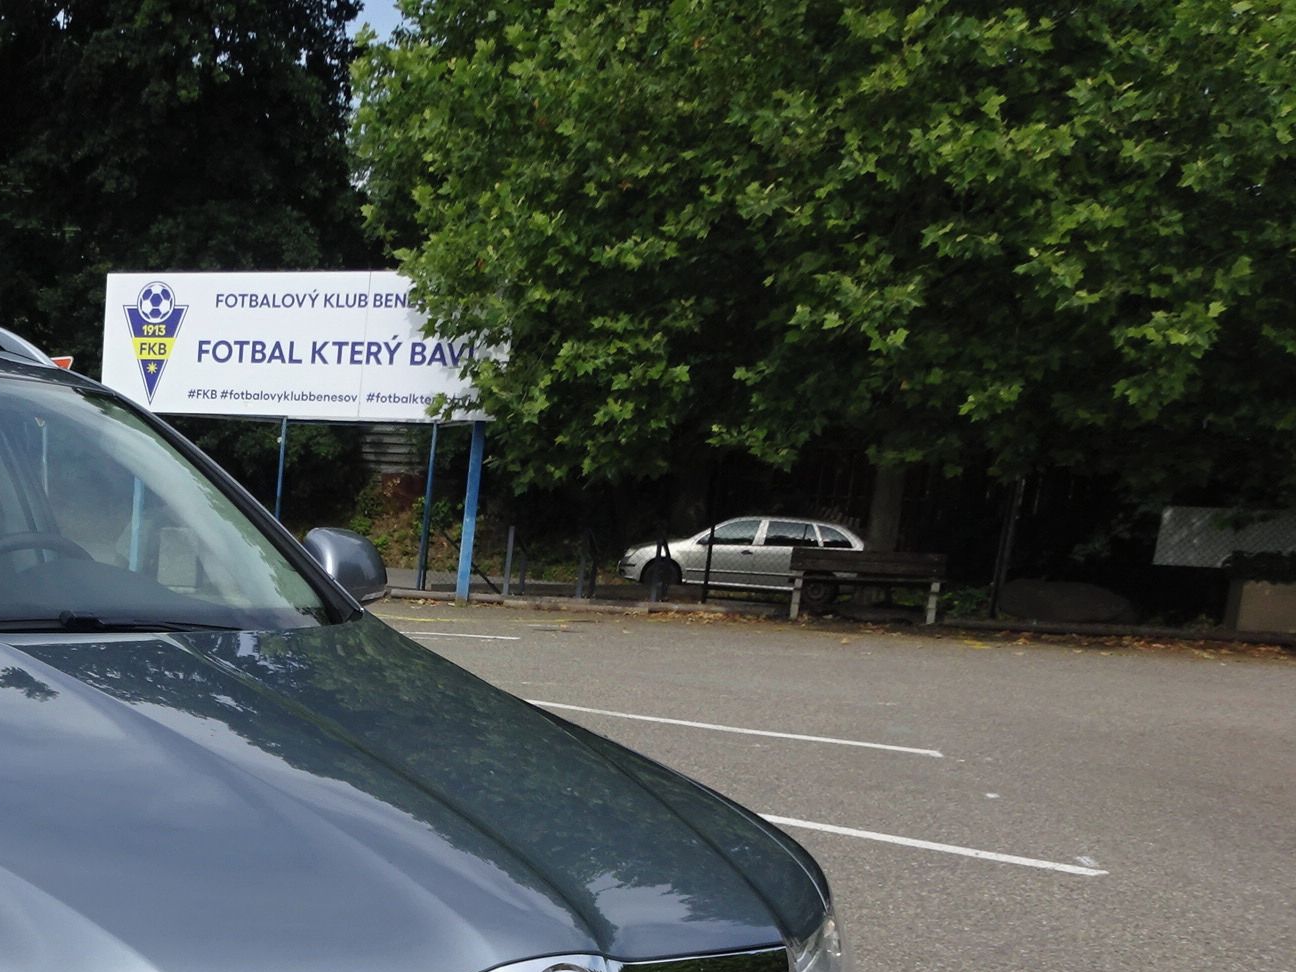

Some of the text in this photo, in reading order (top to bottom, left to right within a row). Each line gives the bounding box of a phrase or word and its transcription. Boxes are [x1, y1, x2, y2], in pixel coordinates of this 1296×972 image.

[215, 288, 319, 309] FOTBALOVÝ
[323, 293, 368, 309] KLUB
[142, 324, 166, 336] 1913
[139, 342, 167, 355] FKB
[197, 339, 303, 365] FOTBAL
[310, 333, 402, 366] KTERÝ
[187, 389, 217, 400] #FKB
[220, 390, 358, 403] #fotbalovyklubbenesov
